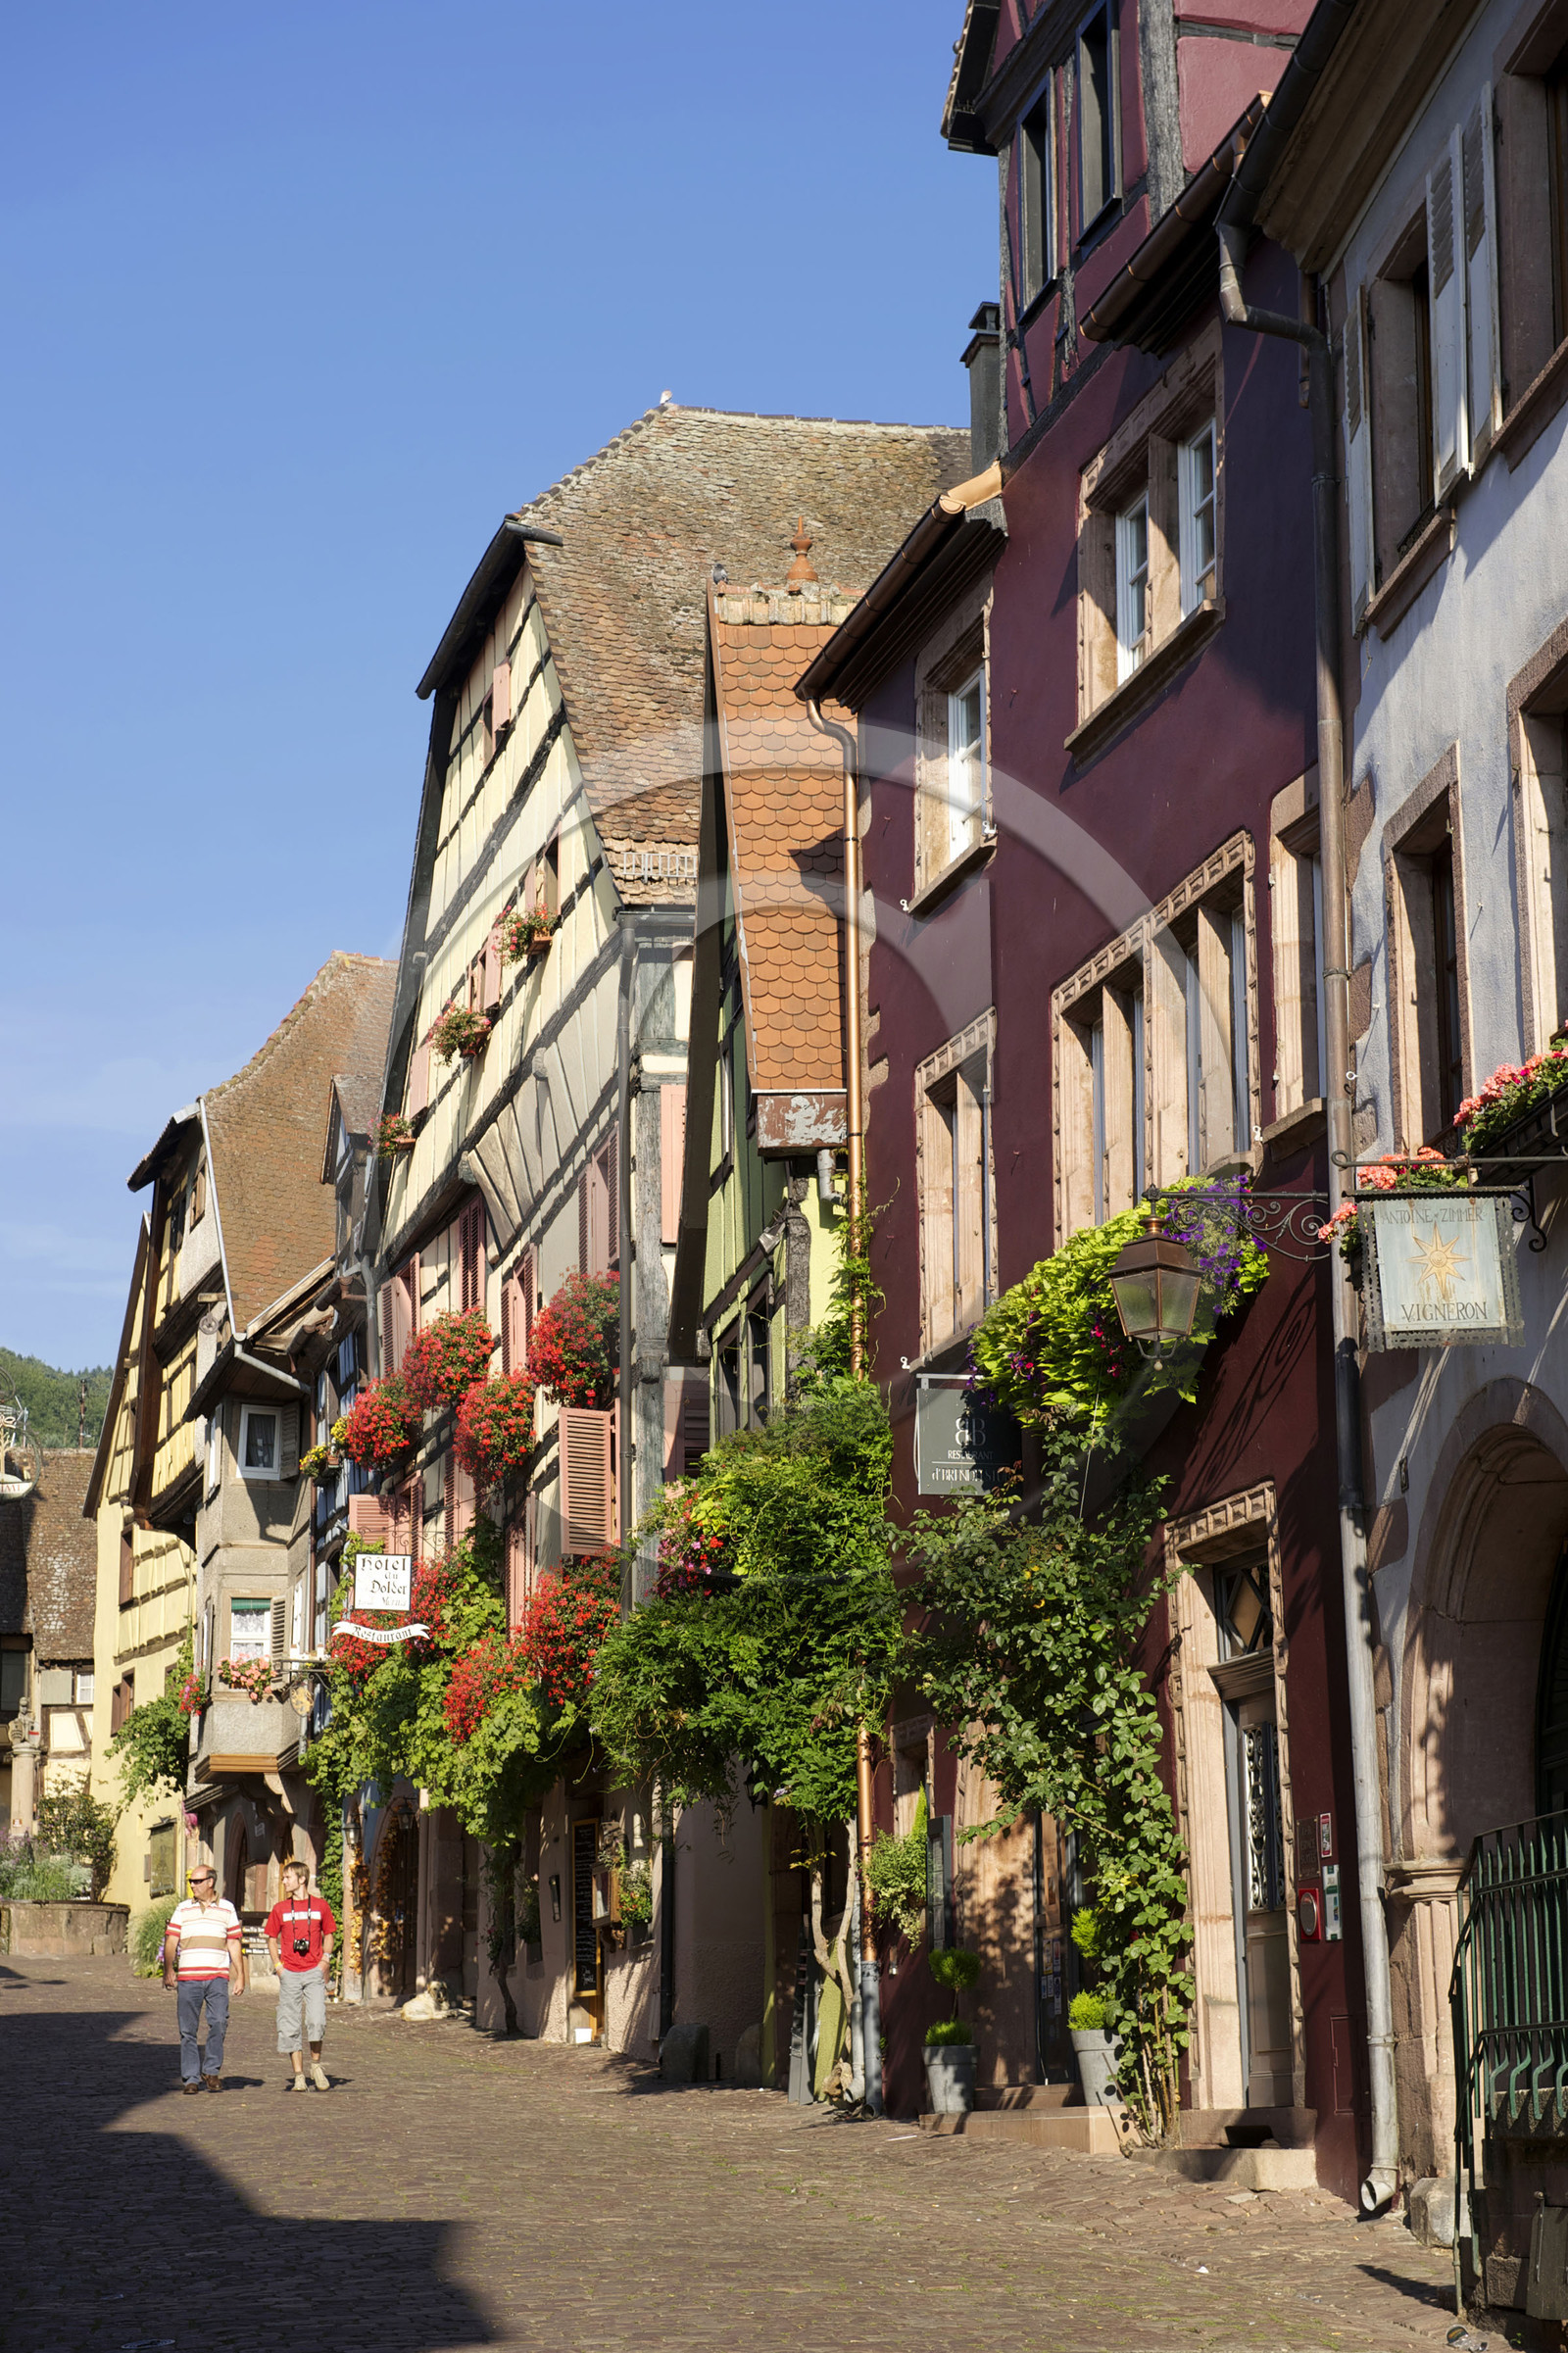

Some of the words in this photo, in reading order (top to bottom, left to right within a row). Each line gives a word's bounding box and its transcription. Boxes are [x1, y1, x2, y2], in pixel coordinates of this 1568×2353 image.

[1383, 1208, 1433, 1224] ANTOINE
[1440, 1206, 1484, 1223] ZIMMER
[1400, 1301, 1489, 1323] VIGNERON
[947, 1449, 994, 1460] RESTAURANT
[361, 1556, 407, 1571] Hôtel
[369, 1579, 408, 1595] Dolder
[352, 1625, 413, 1642] Restaurant
